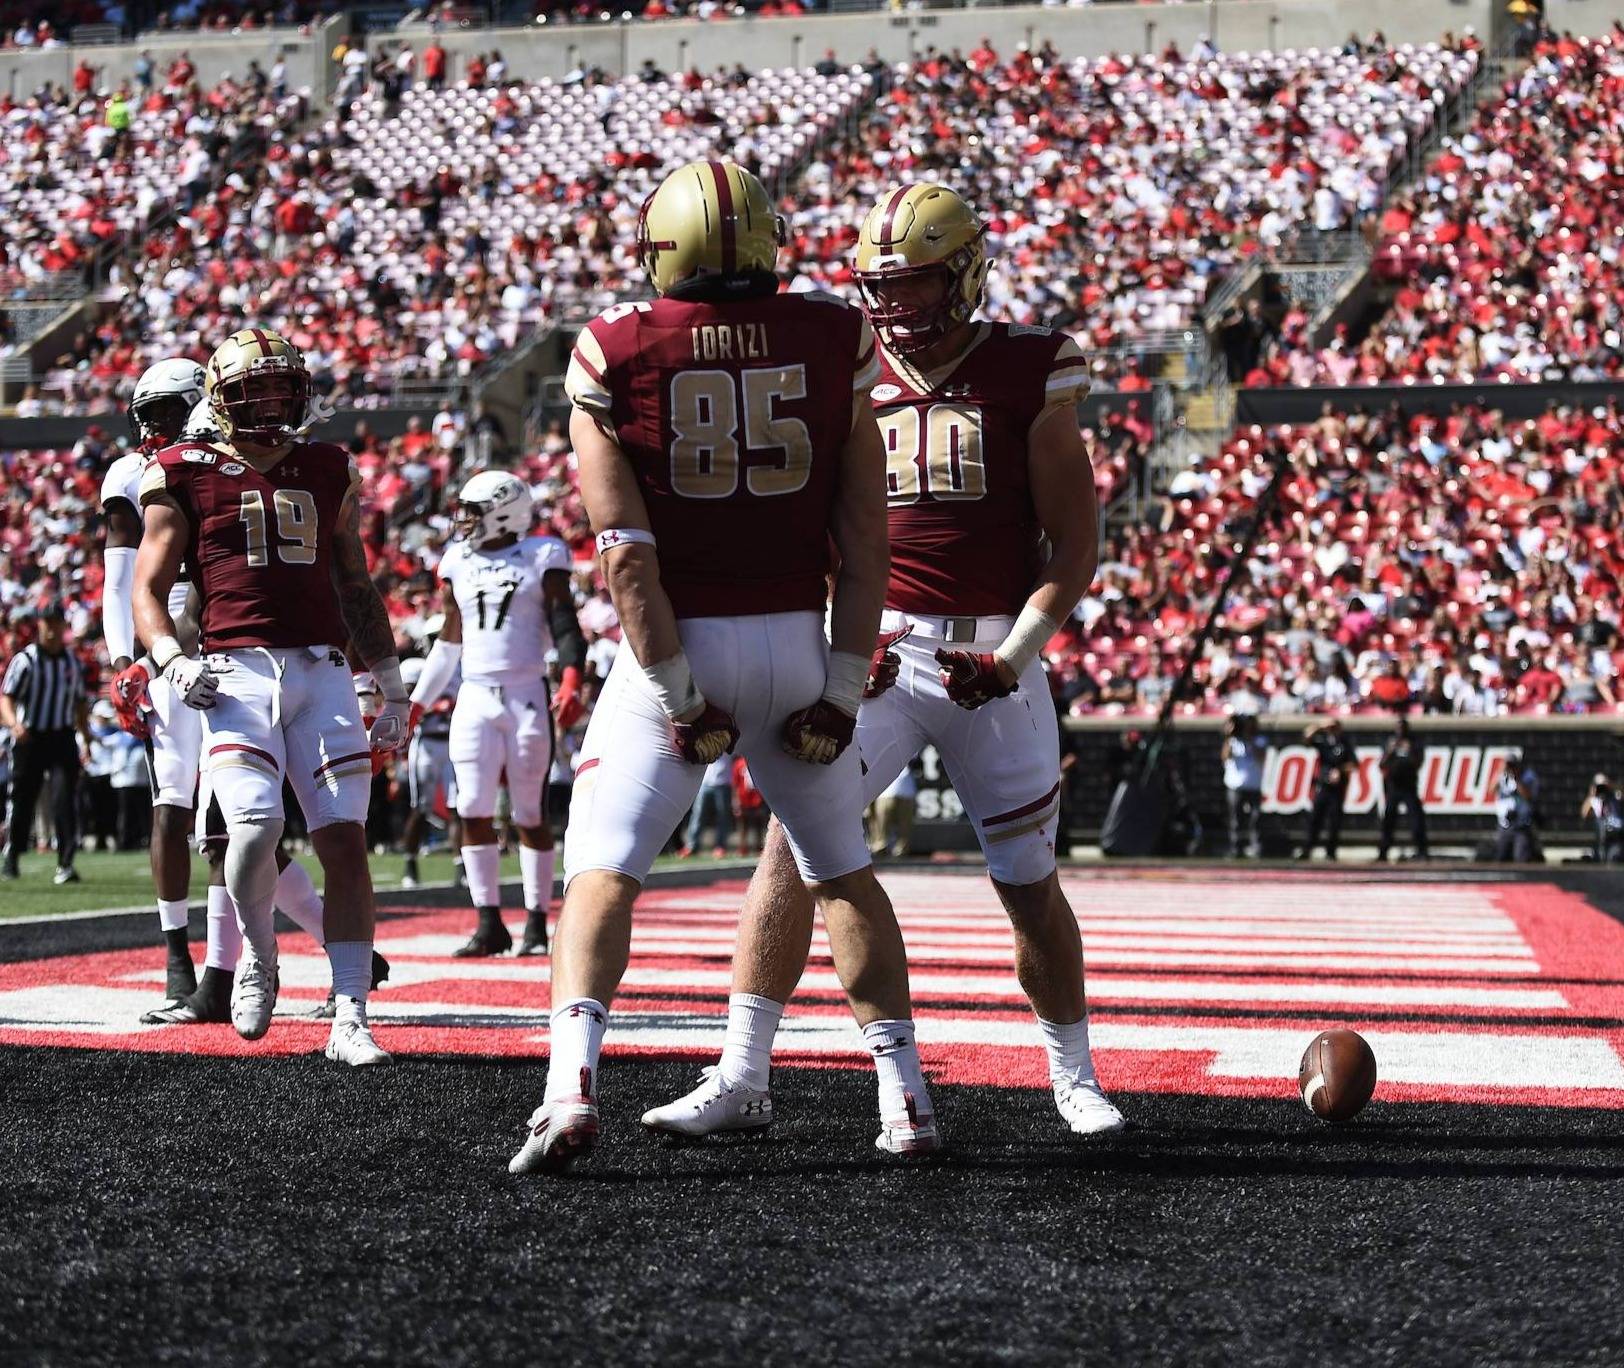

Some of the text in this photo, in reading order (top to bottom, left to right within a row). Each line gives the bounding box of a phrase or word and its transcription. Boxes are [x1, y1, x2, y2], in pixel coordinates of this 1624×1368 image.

[691, 322, 769, 361] IDRIZI
[669, 363, 813, 499] 85
[876, 403, 988, 507] 80
[239, 489, 319, 567] 19
[475, 580, 519, 630] 17
